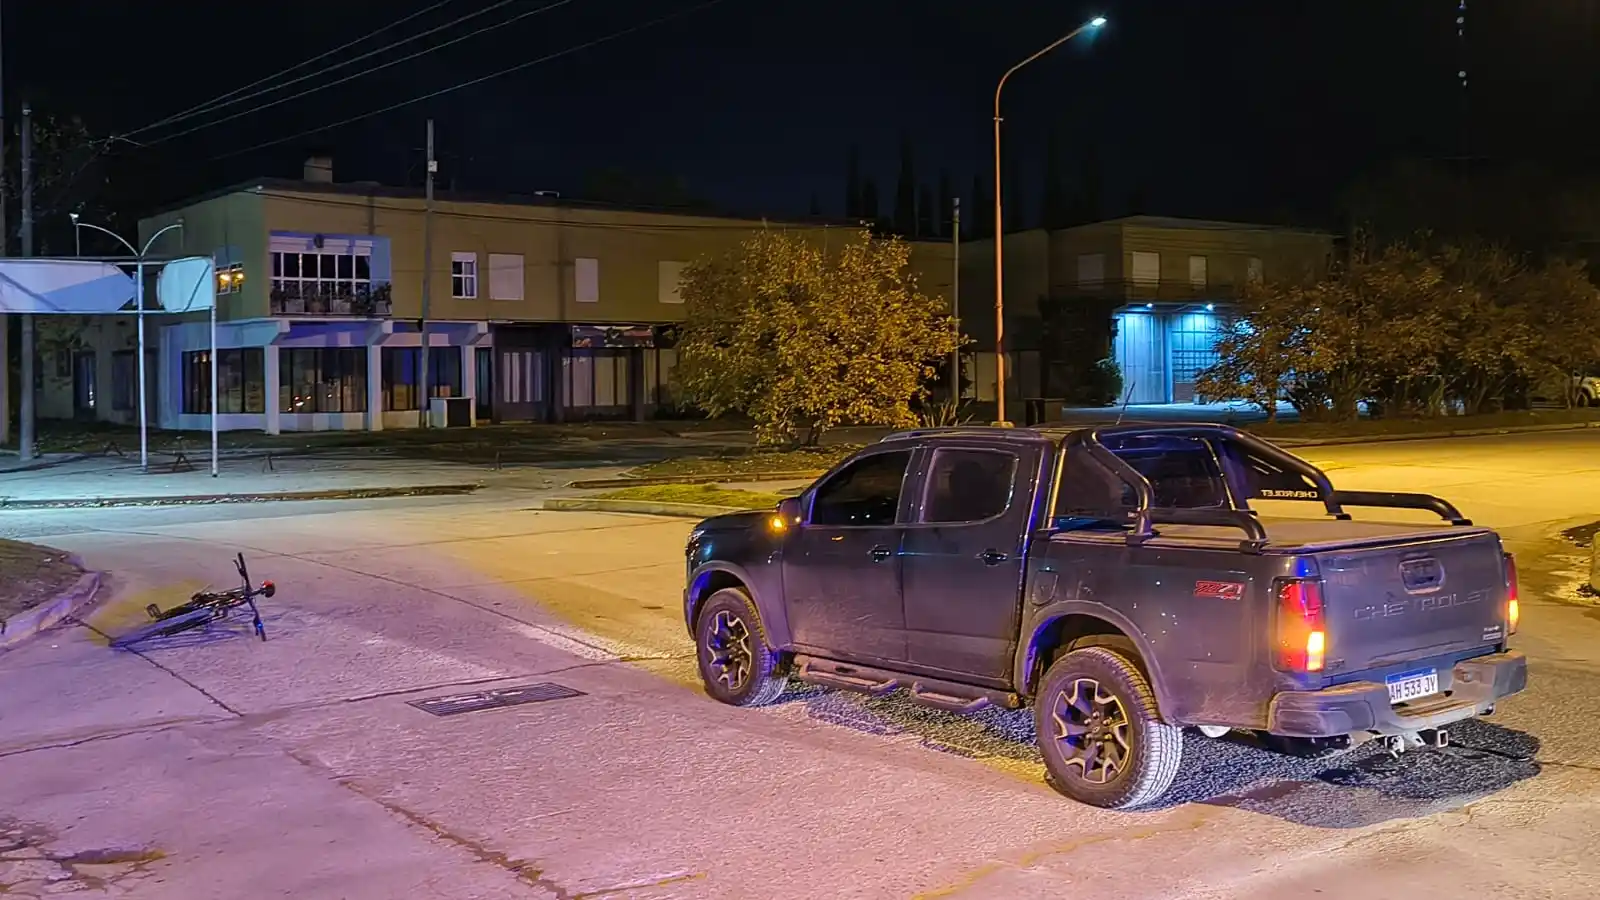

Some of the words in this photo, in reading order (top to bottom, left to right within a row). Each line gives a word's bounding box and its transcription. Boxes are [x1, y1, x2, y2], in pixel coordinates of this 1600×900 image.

[1354, 587, 1492, 620] CHEROLET
[1390, 683, 1402, 700] AH
[1404, 679, 1422, 697] 533
[1424, 675, 1436, 693] JY
